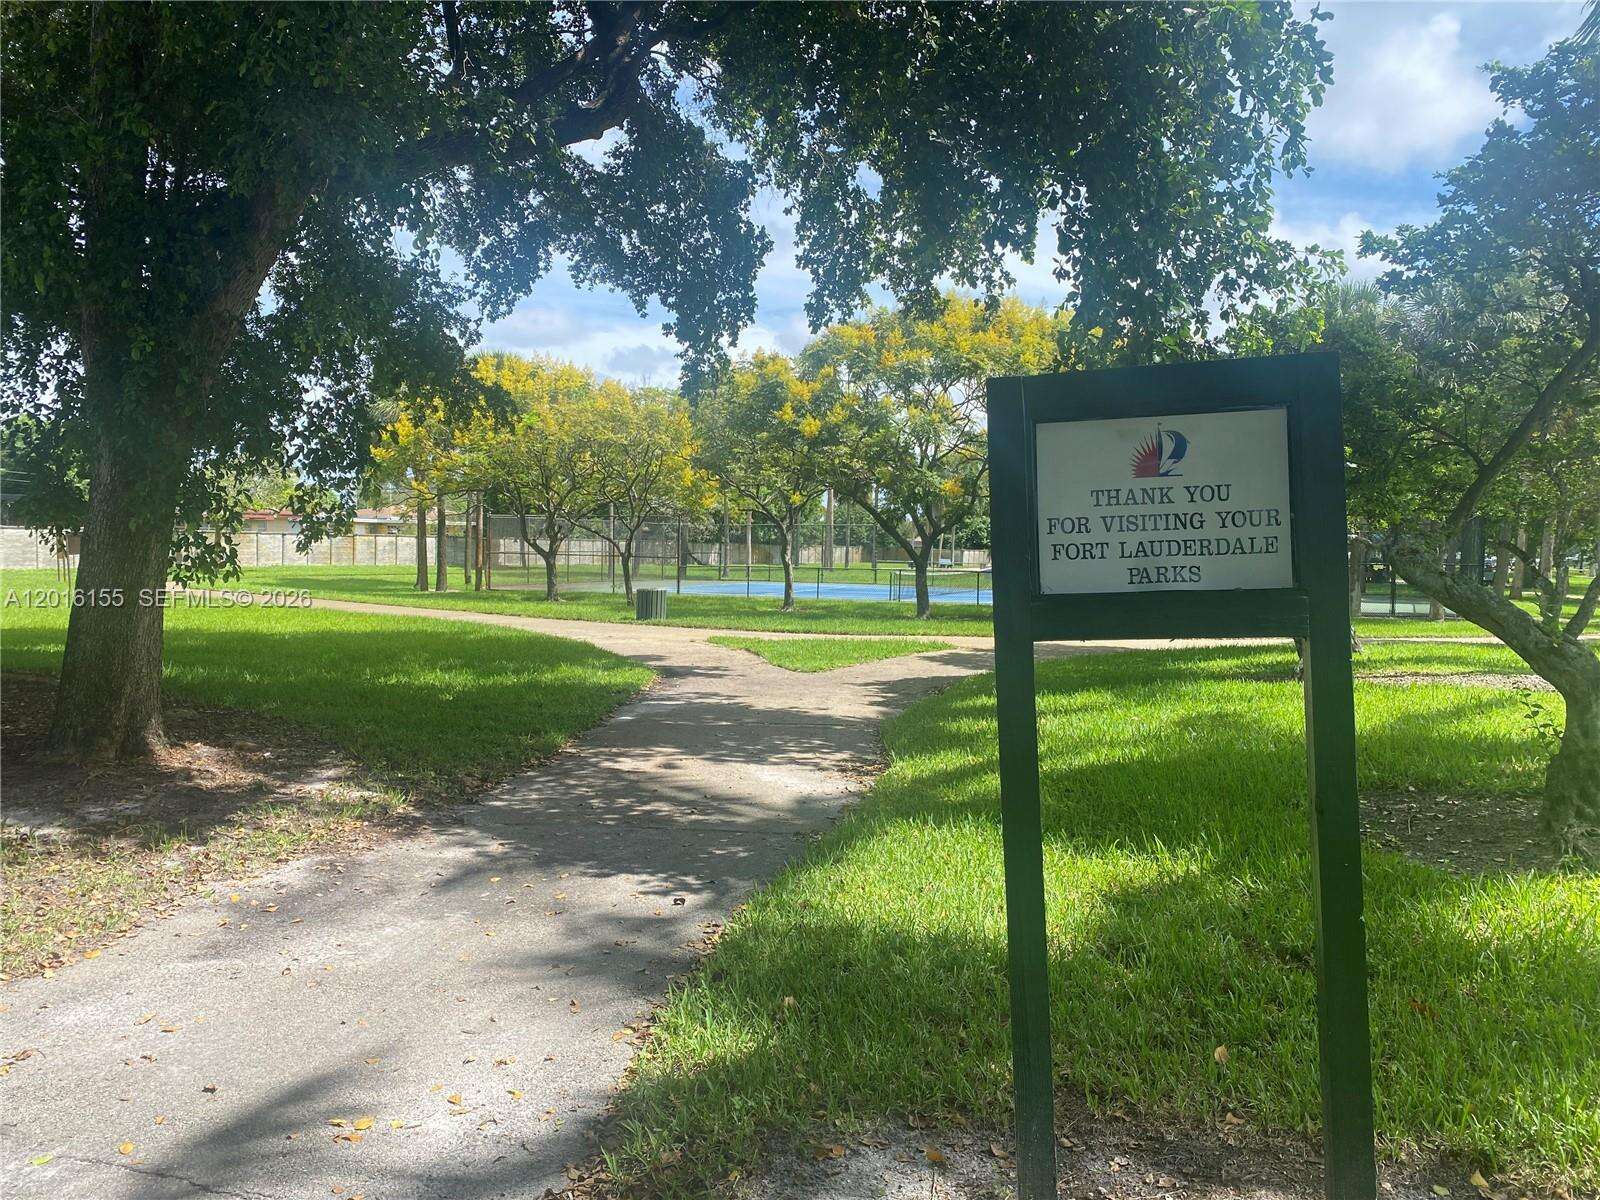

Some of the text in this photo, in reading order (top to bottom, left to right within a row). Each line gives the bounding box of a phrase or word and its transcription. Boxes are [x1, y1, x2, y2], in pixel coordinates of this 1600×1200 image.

[1091, 484, 1232, 507] THANK YOU
[1046, 508, 1281, 535] FOR VISITING YOUR
[1051, 536, 1279, 561] FORT LAUDERDALE
[1127, 565, 1202, 585] PARKS
